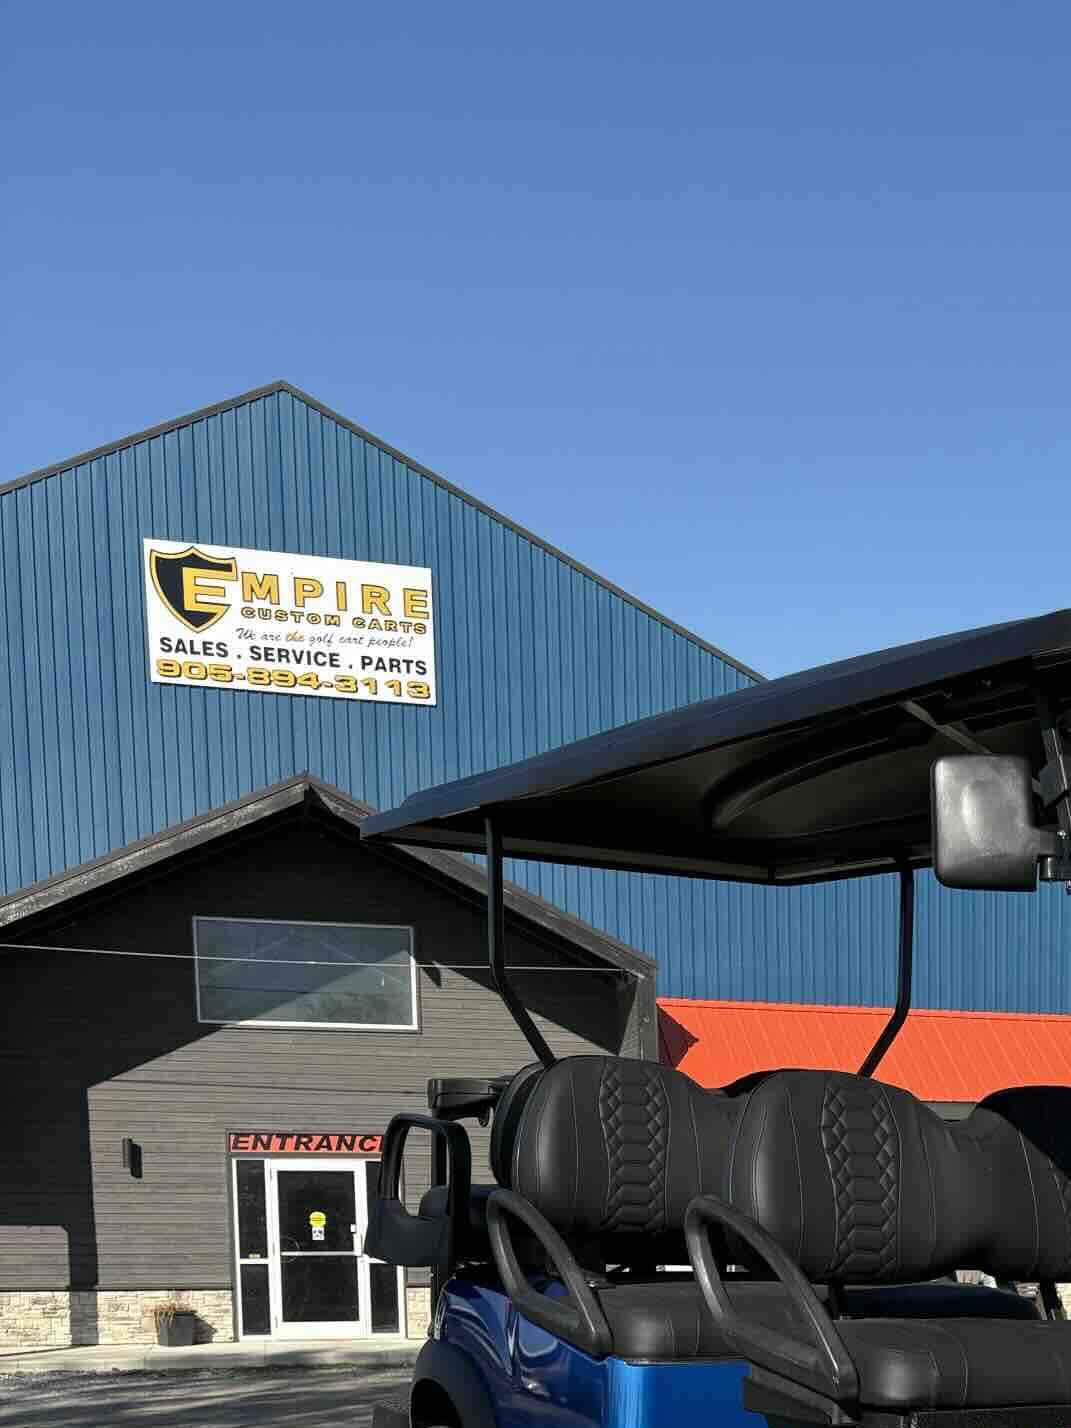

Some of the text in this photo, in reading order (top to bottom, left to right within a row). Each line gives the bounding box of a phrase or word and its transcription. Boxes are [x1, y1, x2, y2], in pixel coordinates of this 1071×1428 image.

[182, 566, 430, 619] EMPIRE
[240, 606, 427, 635] CUSTOM CARTS
[235, 627, 414, 649] We are the golf cart people!
[159, 636, 428, 675] SALES SERVICE PARTS
[157, 659, 431, 699] 905-894-3113
[231, 1134, 384, 1152] ENTRANC
